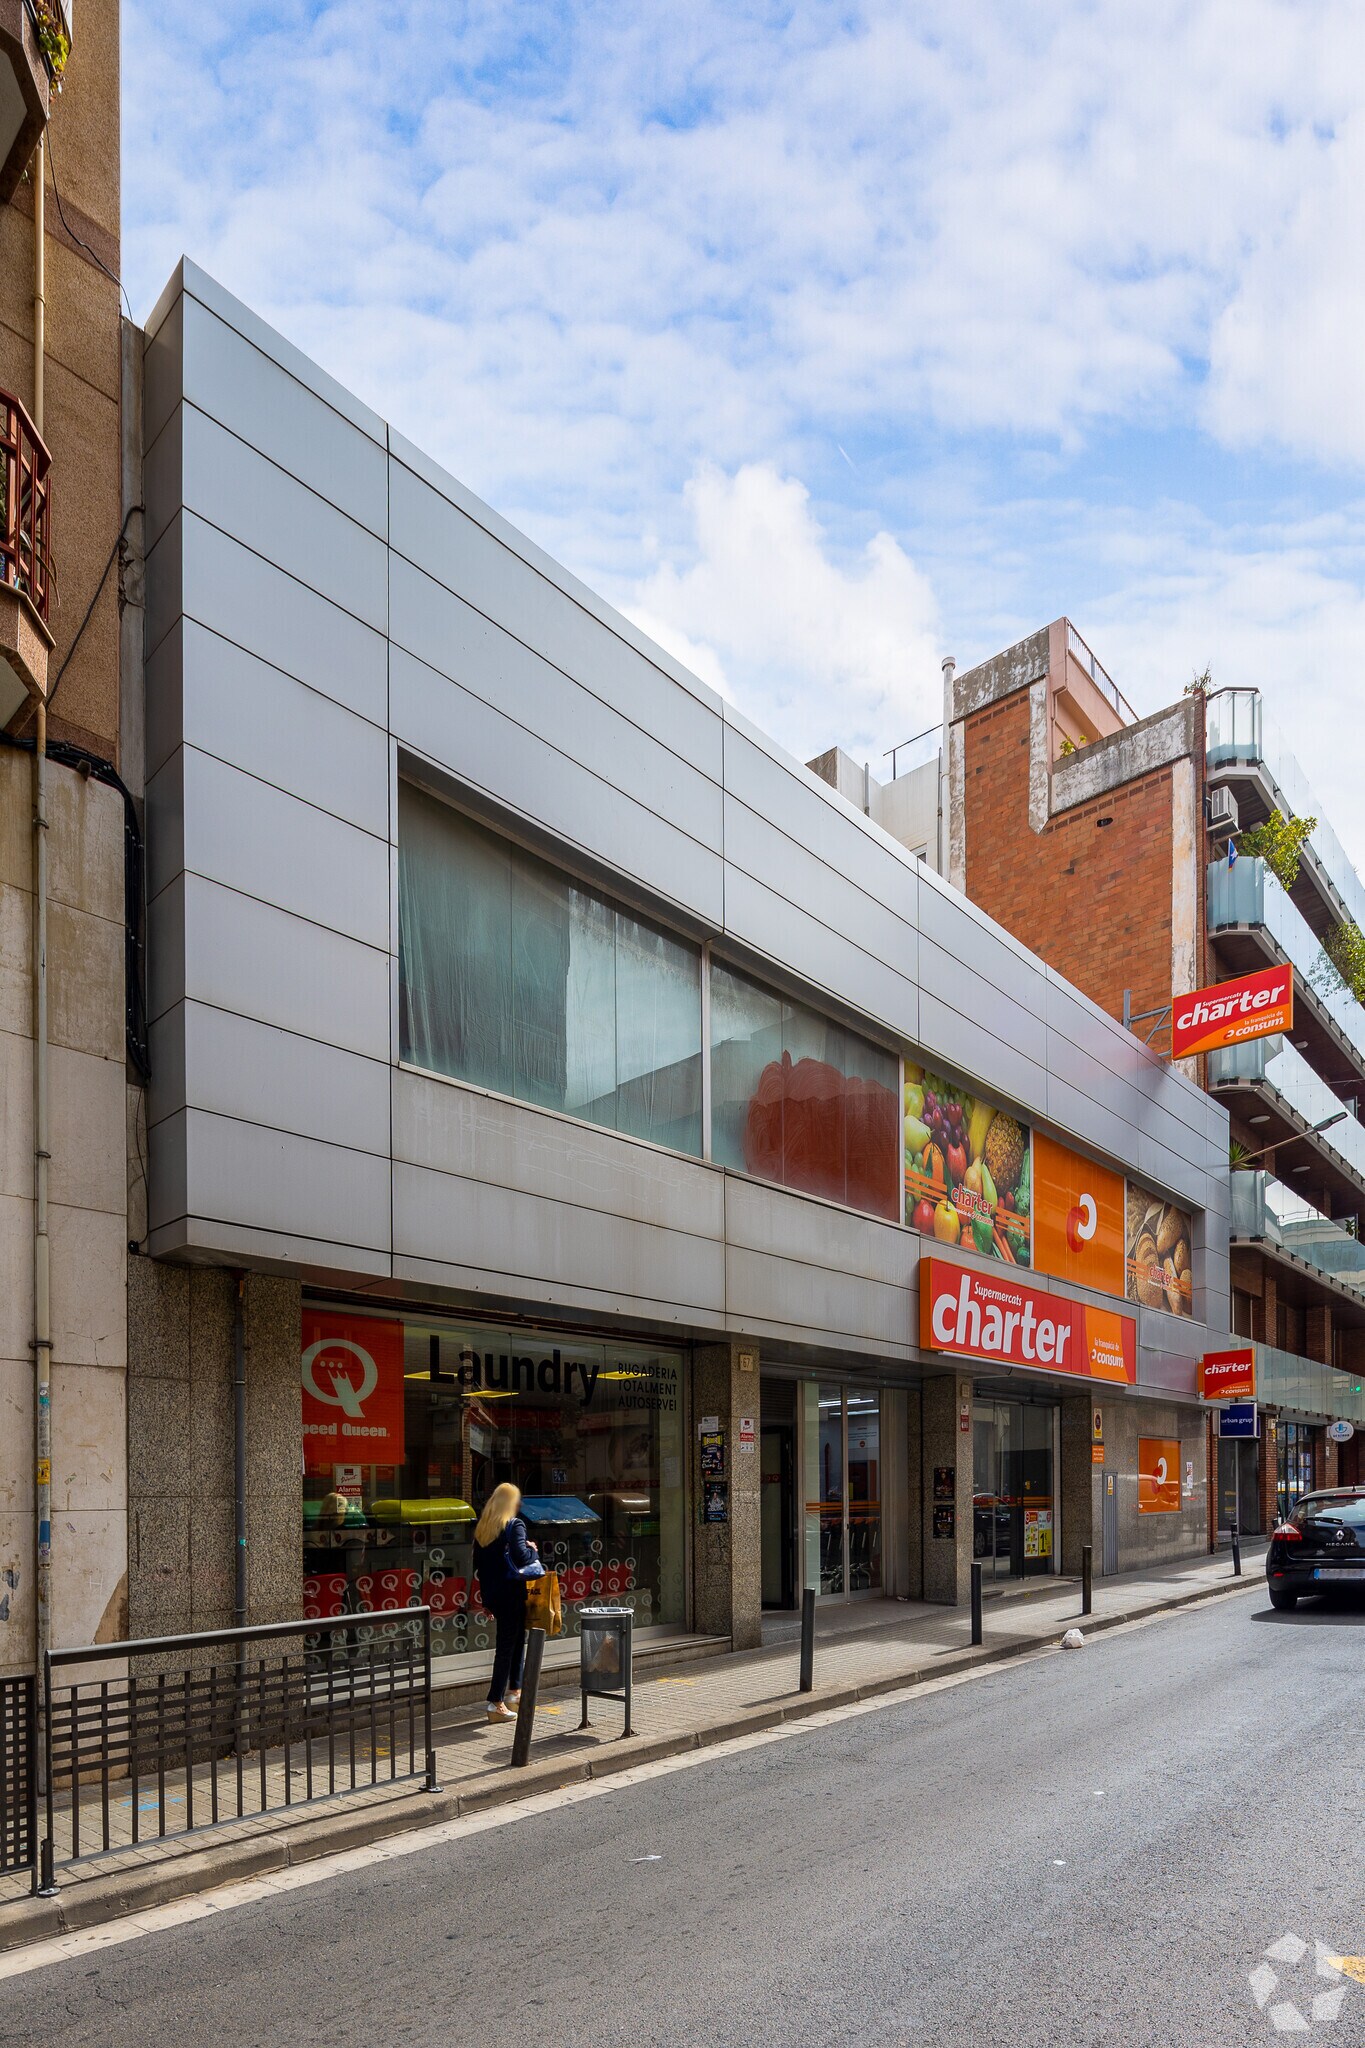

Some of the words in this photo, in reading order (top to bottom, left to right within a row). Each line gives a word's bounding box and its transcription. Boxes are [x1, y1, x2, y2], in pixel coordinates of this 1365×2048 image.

[1177, 985, 1285, 1030] charter
[1235, 1016, 1284, 1037] consum
[951, 1183, 993, 1215] charter
[974, 1281, 1022, 1306] Supermercats
[932, 1274, 1071, 1364] charter
[1097, 1351, 1124, 1369] consum
[1204, 1362, 1251, 1375] charter
[430, 1335, 600, 1407] Laundry
[618, 1363, 677, 1380] BUGADERIA
[618, 1380, 677, 1396] TOTALMENT
[618, 1395, 677, 1412] AUTOSERVEI
[302, 1422, 337, 1435] peed
[342, 1423, 387, 1437] Queen
